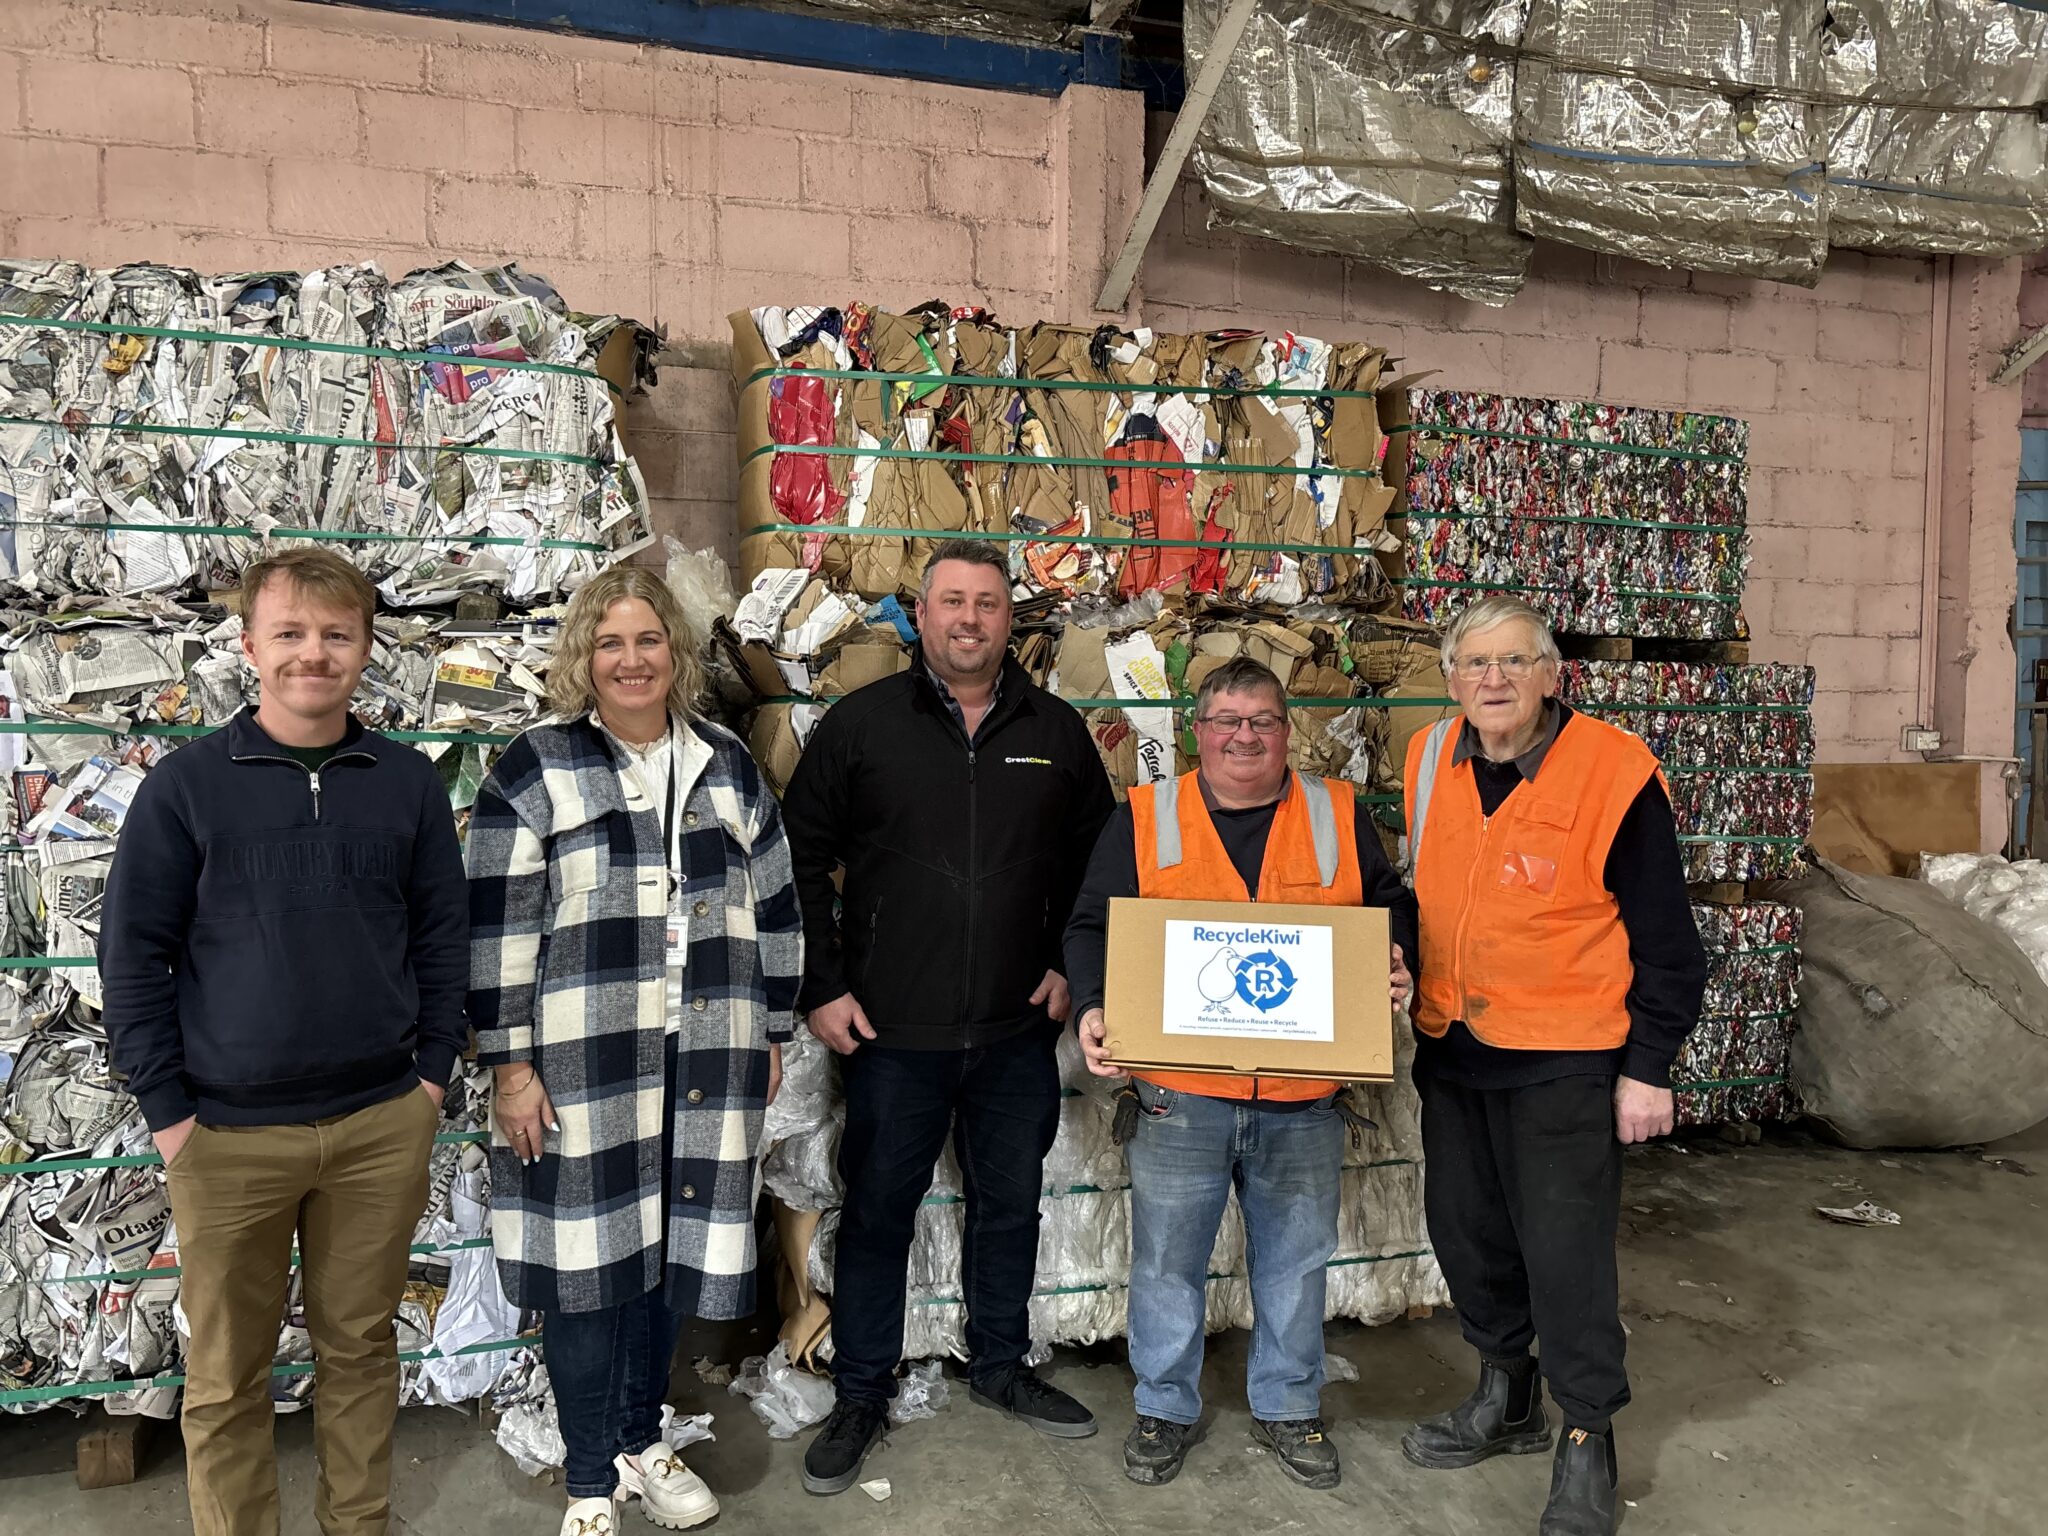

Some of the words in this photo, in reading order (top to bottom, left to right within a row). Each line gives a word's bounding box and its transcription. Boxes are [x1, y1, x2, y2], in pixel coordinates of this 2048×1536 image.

[445, 294, 507, 310] Southlan
[452, 343, 470, 354] pro
[469, 376, 489, 391] pro
[471, 396, 491, 413] strikes
[1140, 656, 1167, 689] CRISPY
[1123, 672, 1138, 690] SPICE
[1005, 756, 1052, 765] CrestClean
[1193, 926, 1300, 945] RecycleKiwi
[1274, 1019, 1298, 1027] Recycle
[104, 1207, 172, 1244] Otago
